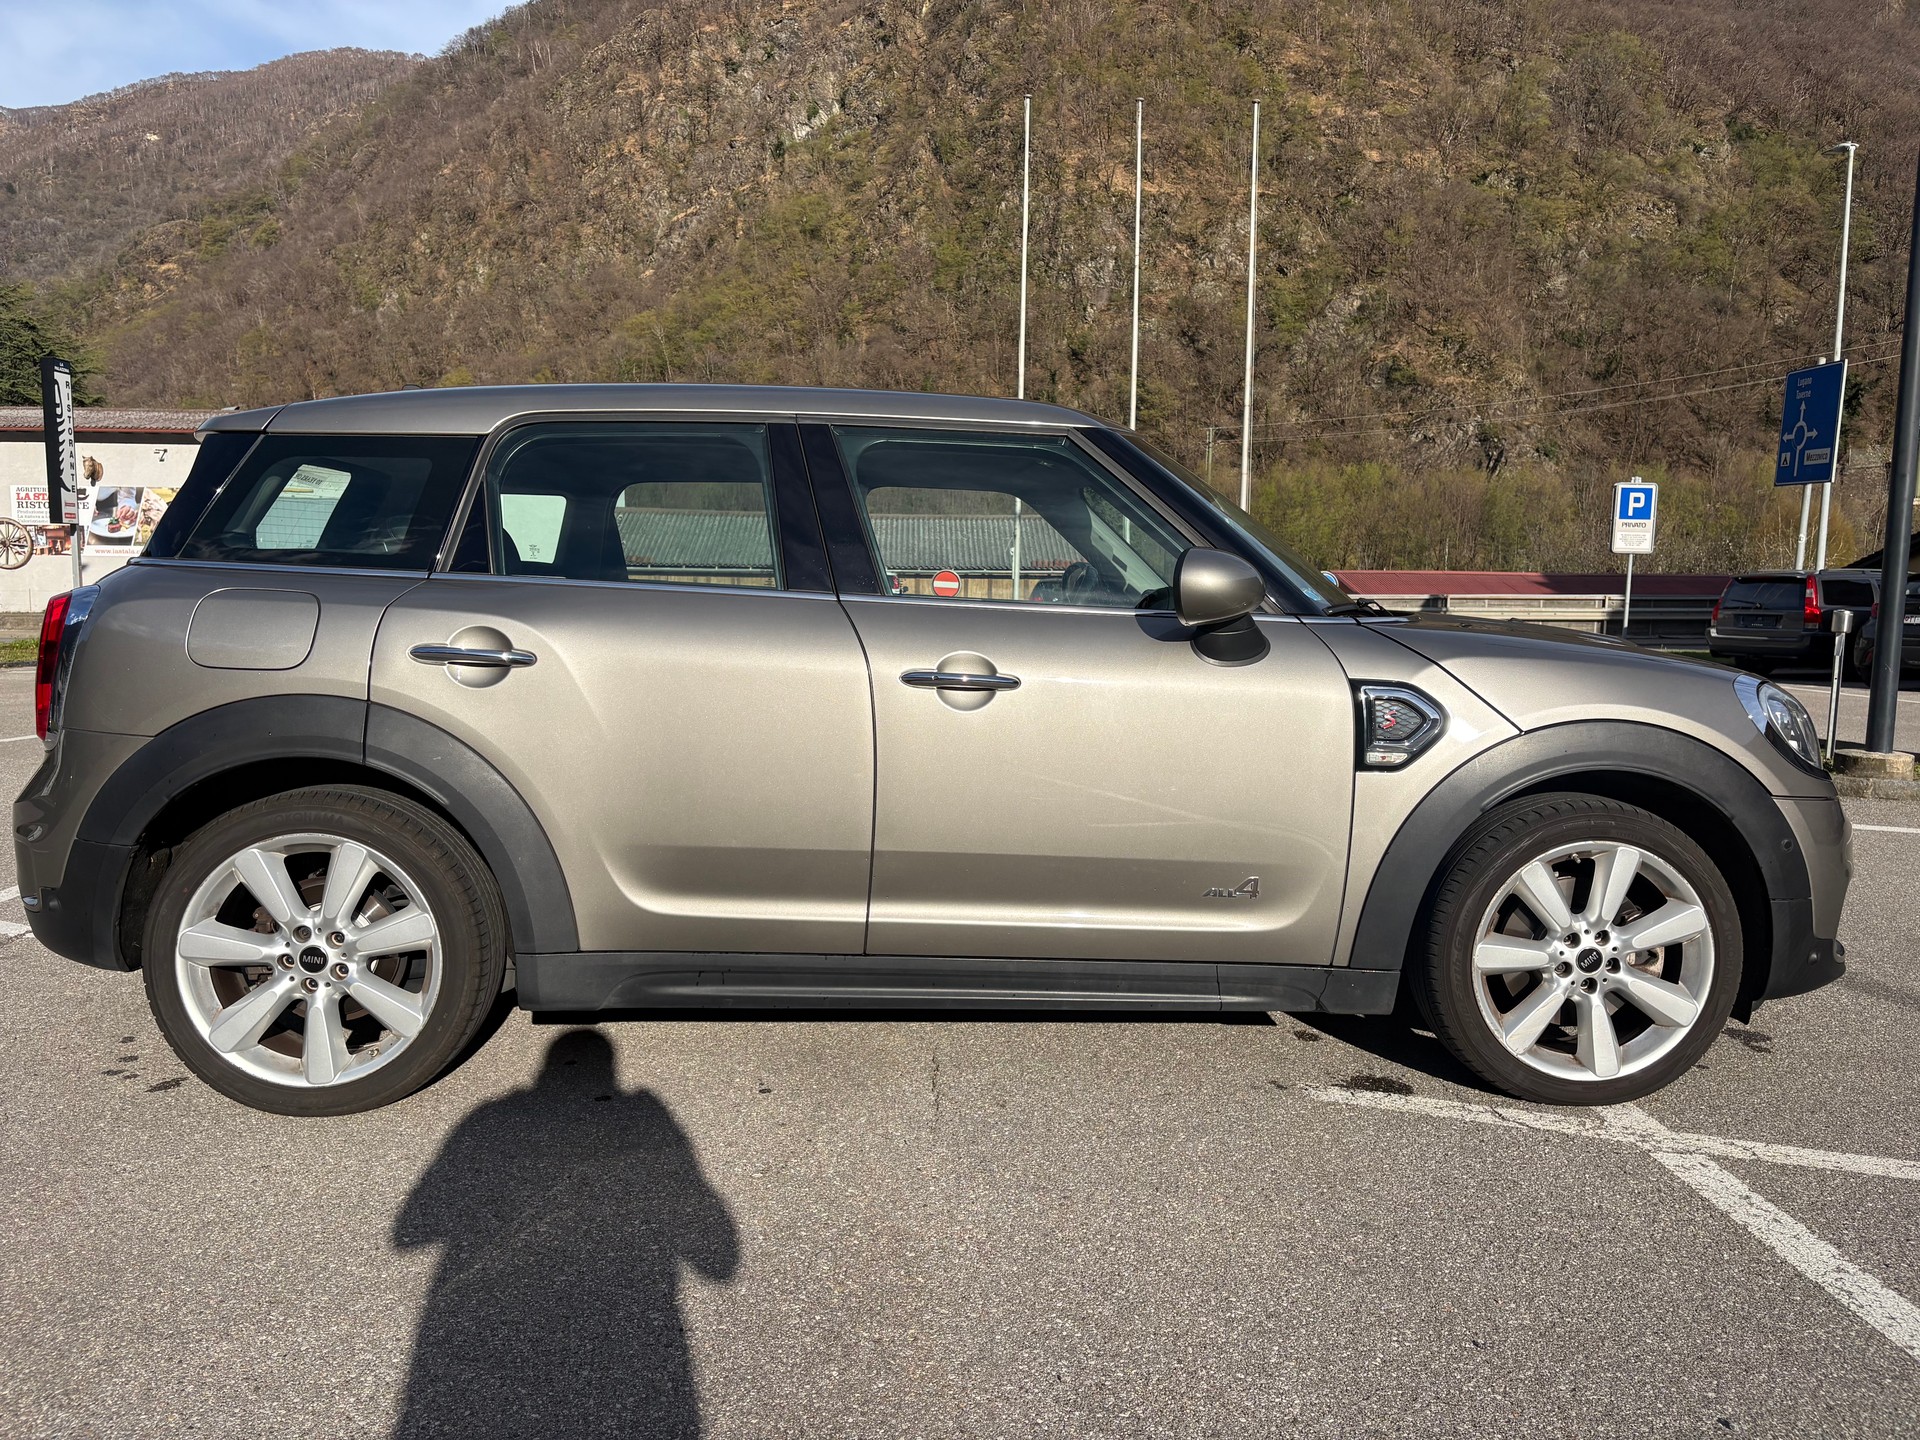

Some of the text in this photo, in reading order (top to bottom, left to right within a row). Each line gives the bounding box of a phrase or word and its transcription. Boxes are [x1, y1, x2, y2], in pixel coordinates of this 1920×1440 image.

[65, 380, 76, 493] RISTORANTE
[1628, 492, 1645, 516] P
[1379, 710, 1397, 729] S
[302, 955, 324, 965] MINI
[1580, 951, 1599, 969] MINI
